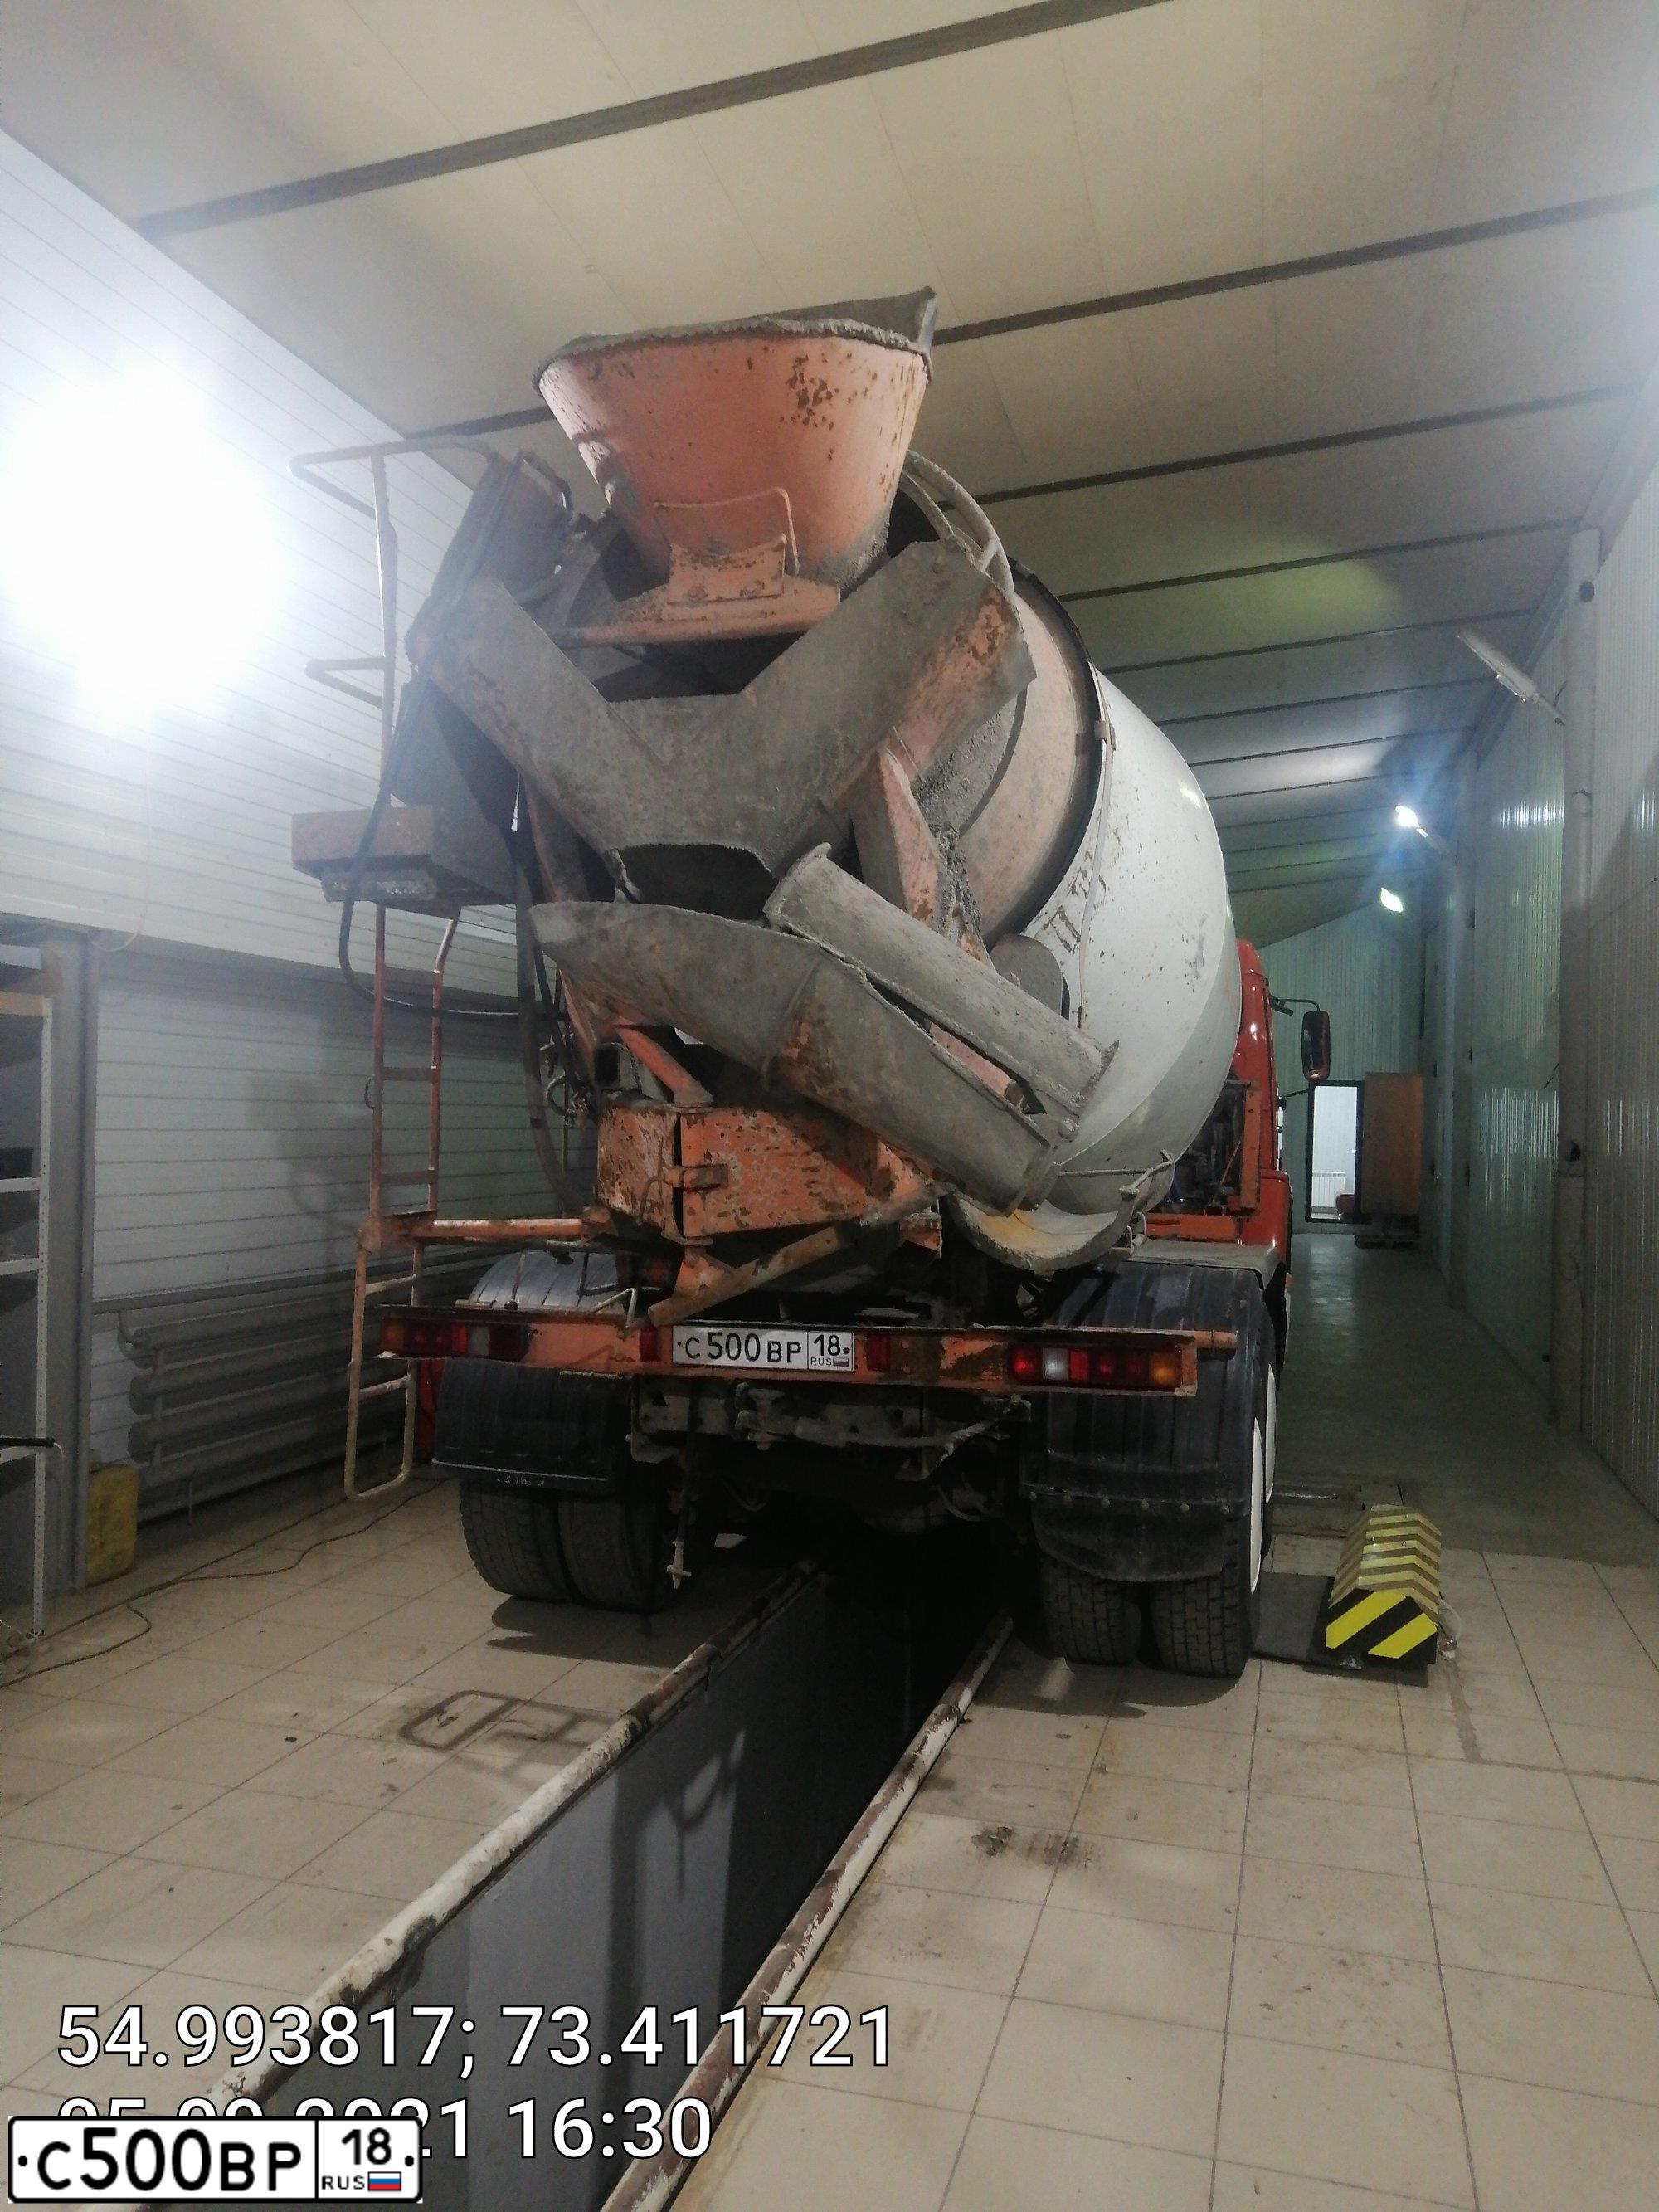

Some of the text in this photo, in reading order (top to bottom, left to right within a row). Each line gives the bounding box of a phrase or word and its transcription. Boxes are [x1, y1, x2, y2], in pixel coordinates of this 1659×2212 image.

[685, 1331, 801, 1363] С500ВР
[813, 1334, 841, 1357] 18
[810, 1357, 832, 1366] RUS
